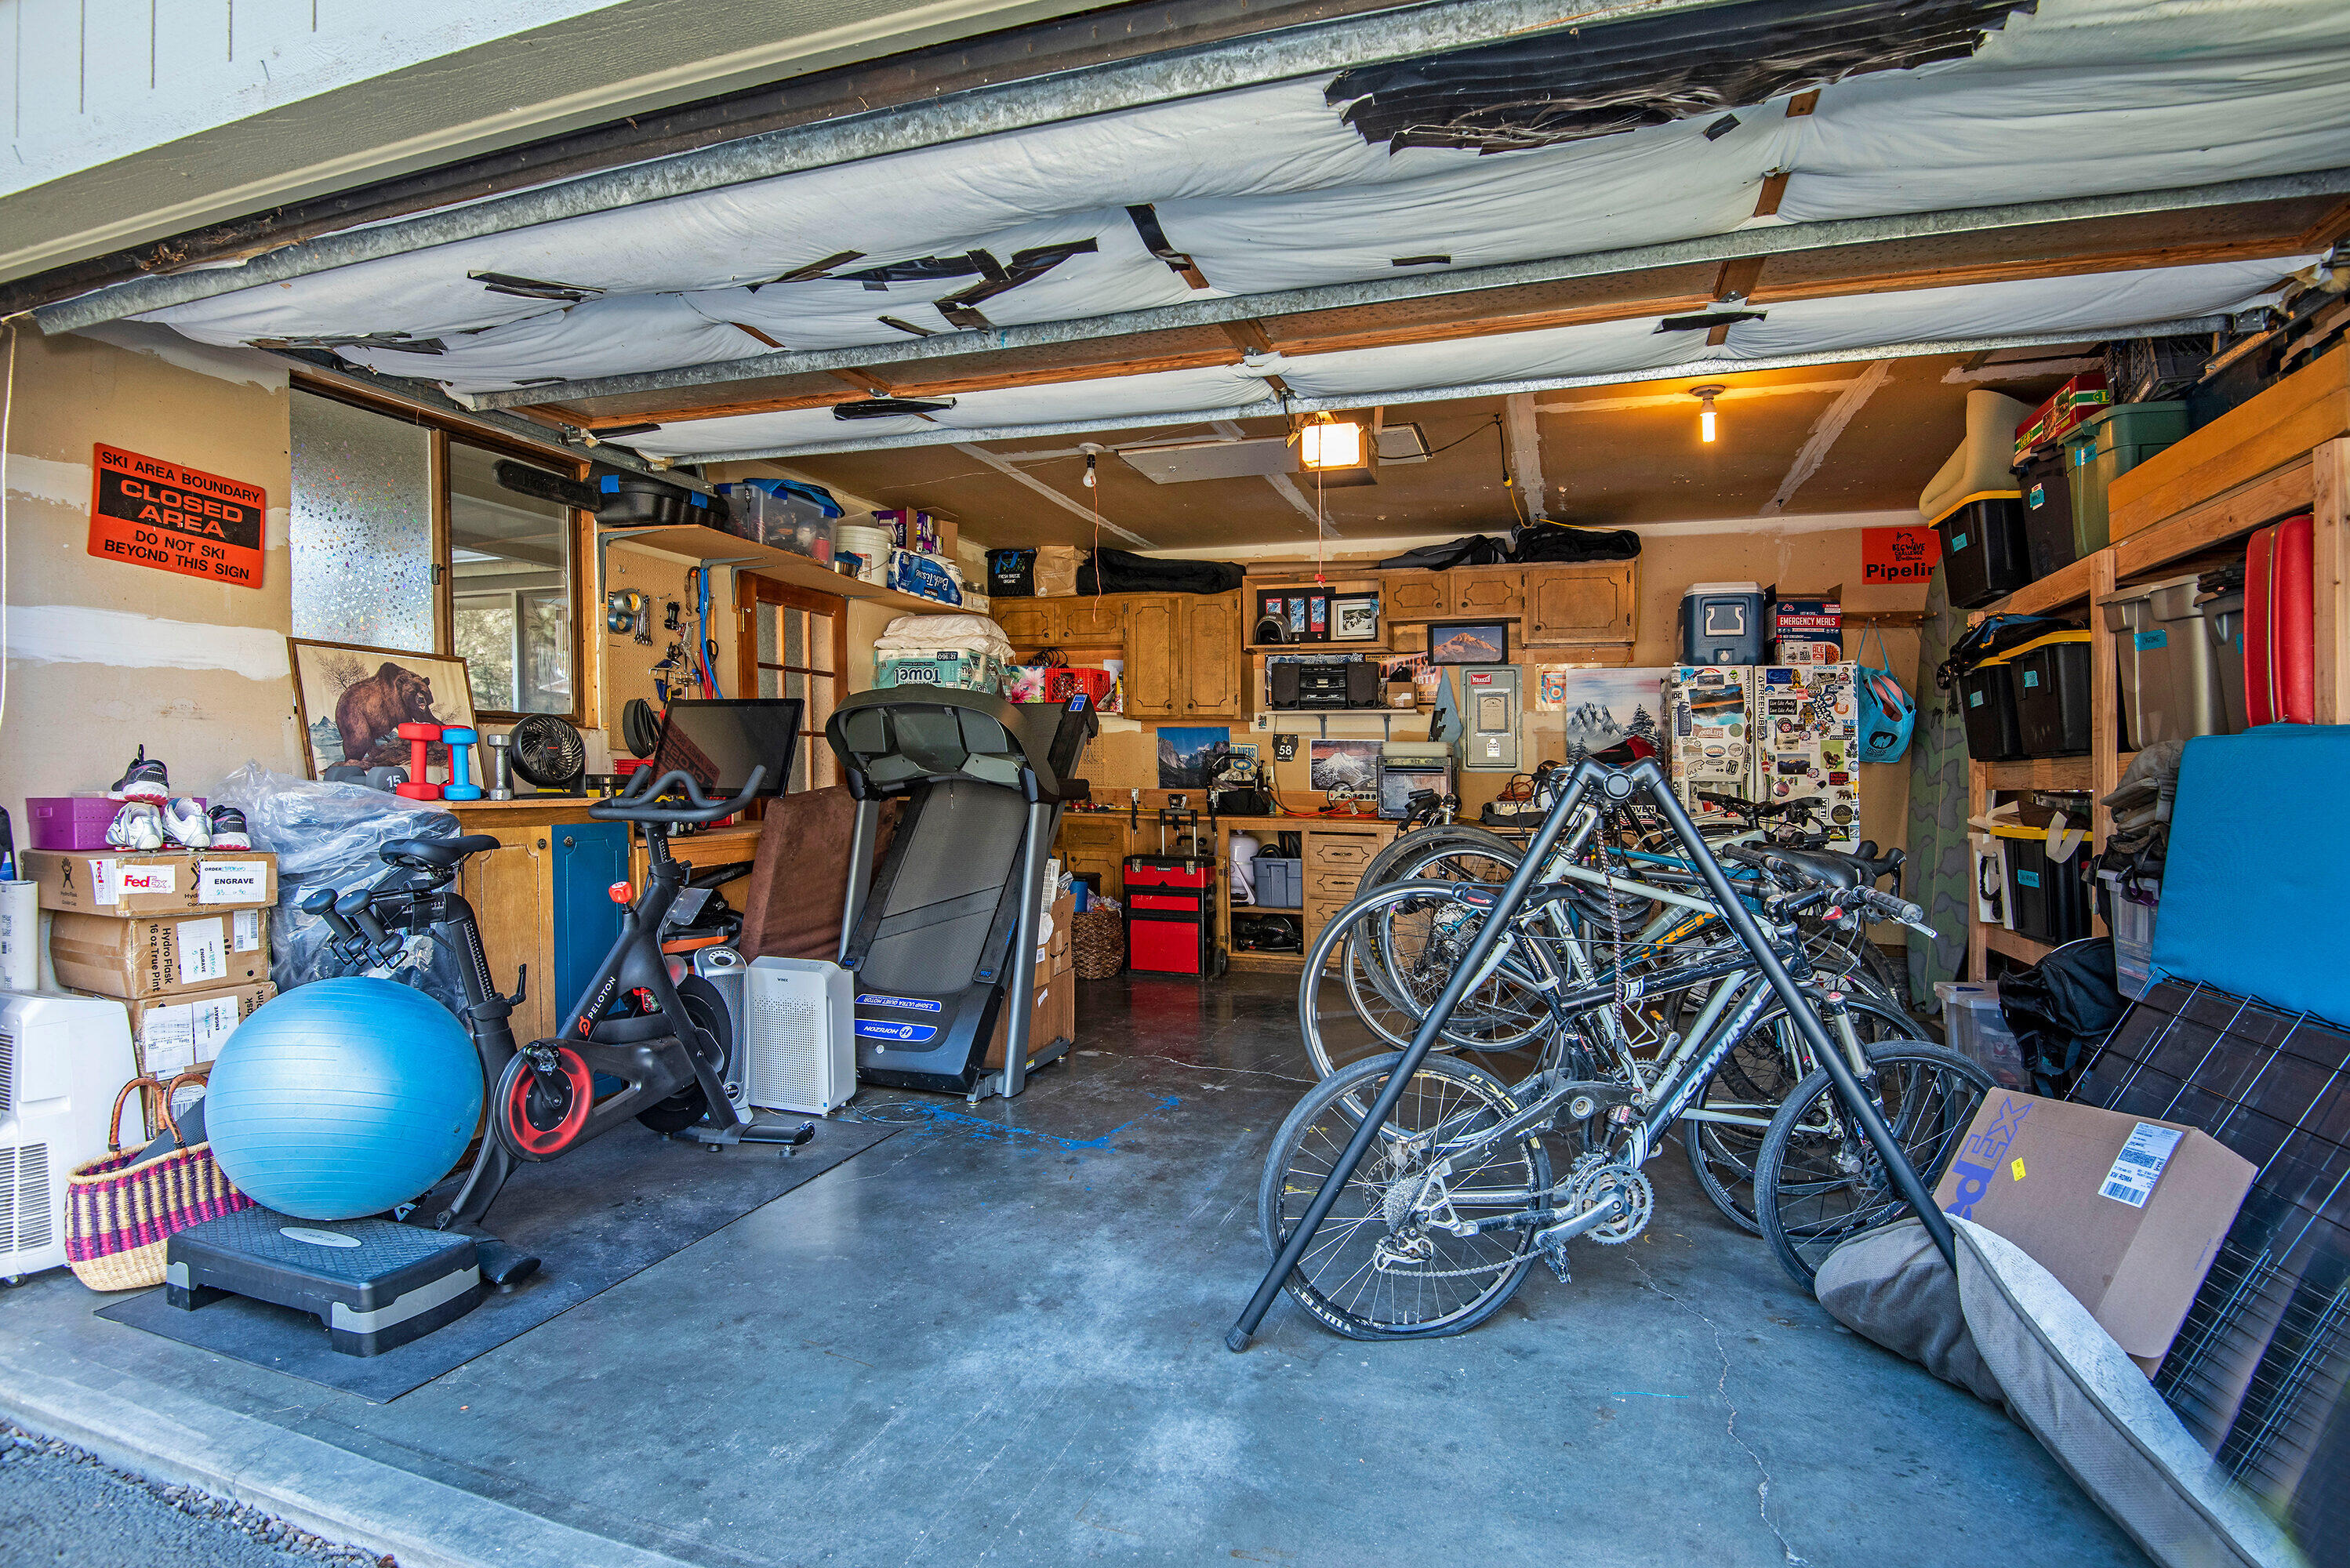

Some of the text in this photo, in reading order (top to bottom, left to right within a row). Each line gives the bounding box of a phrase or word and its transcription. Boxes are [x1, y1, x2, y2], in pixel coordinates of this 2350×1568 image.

[102, 451, 260, 503] SKI AREA BOUNDARY
[121, 479, 243, 523] CLOSED
[137, 504, 226, 539] AREA
[104, 539, 249, 579] BEYOND THIS SIGN
[135, 530, 225, 560] DO NOT SKI
[1905, 543, 1926, 551] WAVE
[1780, 617, 1836, 626] EMERGENCY MEALS
[894, 667, 942, 684] Towel
[1279, 745, 1292, 755] 58
[387, 775, 401, 788] 15
[124, 875, 168, 888] FedEx
[150, 924, 162, 992] 16 oz True Pint
[162, 927, 174, 985] Hydro Flask
[1521, 938, 1541, 973] THOMSON
[587, 976, 616, 1019] PELOTON
[915, 1001, 934, 1010] 2.50HP
[863, 1025, 899, 1035] HORIZON
[1669, 993, 1763, 1116] SCHWINN
[1300, 1291, 1343, 1328] WTB
